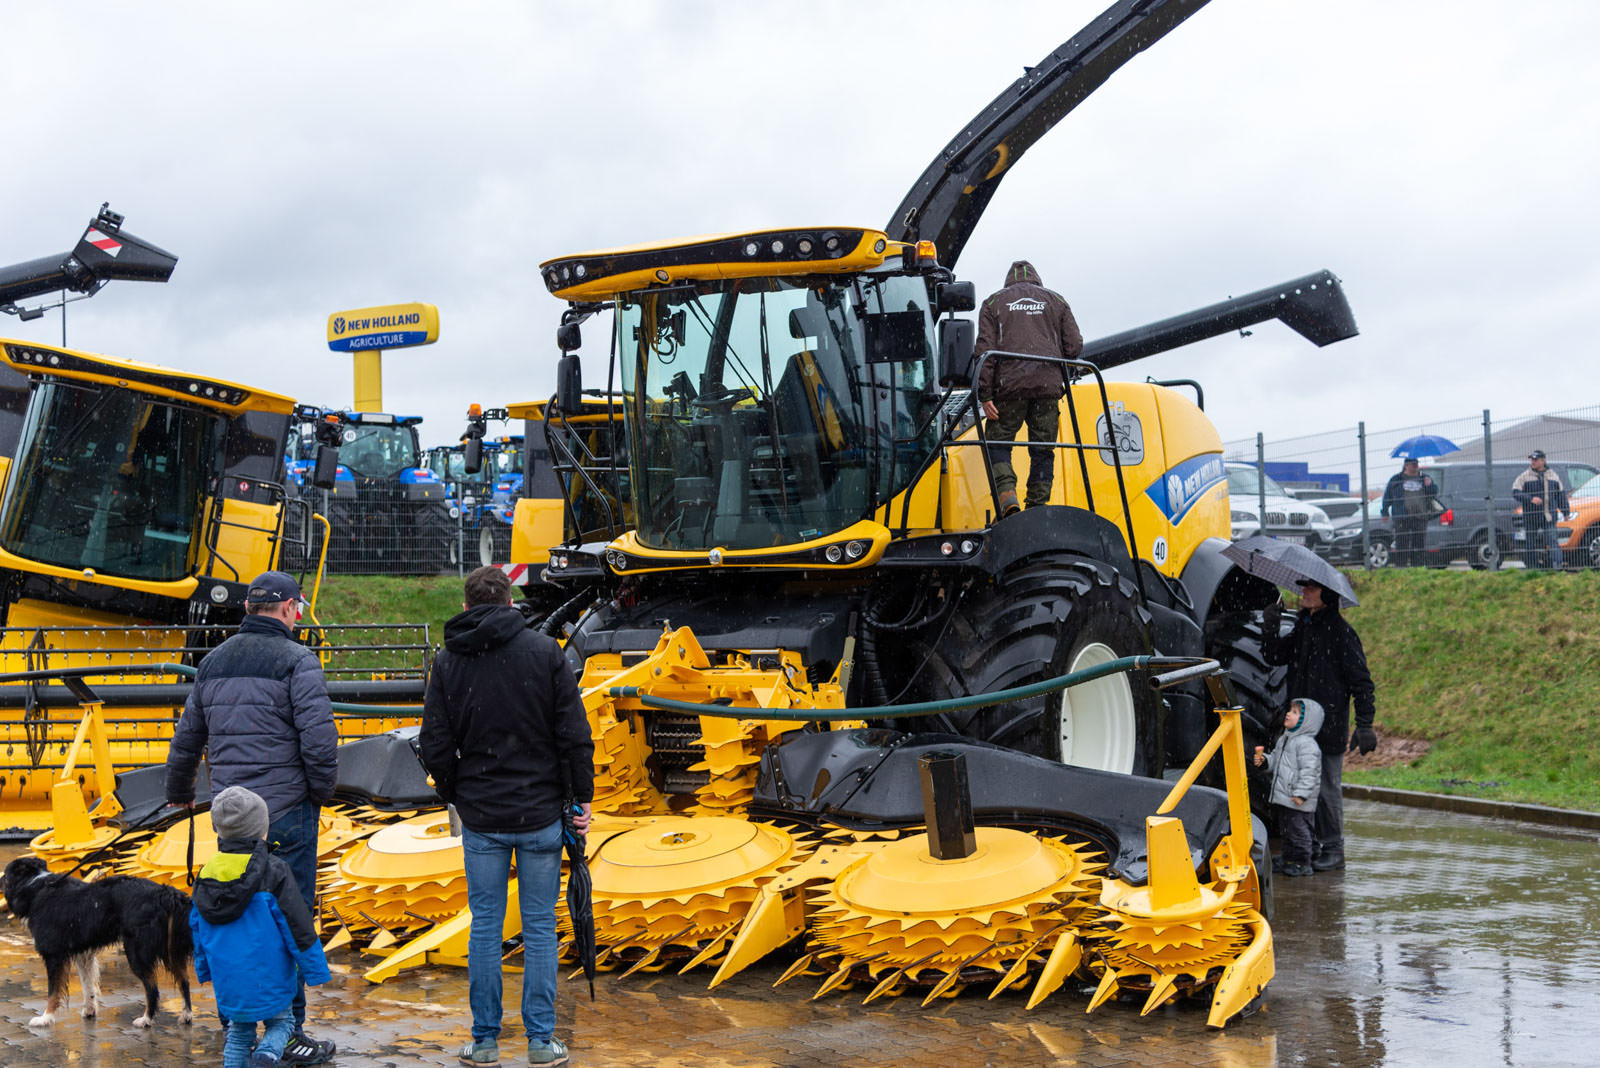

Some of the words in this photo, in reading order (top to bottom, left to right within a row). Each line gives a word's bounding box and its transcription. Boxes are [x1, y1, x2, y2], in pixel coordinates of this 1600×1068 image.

[1006, 301, 1045, 311] Taunus
[348, 318, 370, 331] NEW
[372, 313, 420, 328] HOLLAND
[349, 334, 404, 348] AGRICULTURE
[1184, 469, 1201, 498] NEW
[1155, 541, 1165, 560] 40
